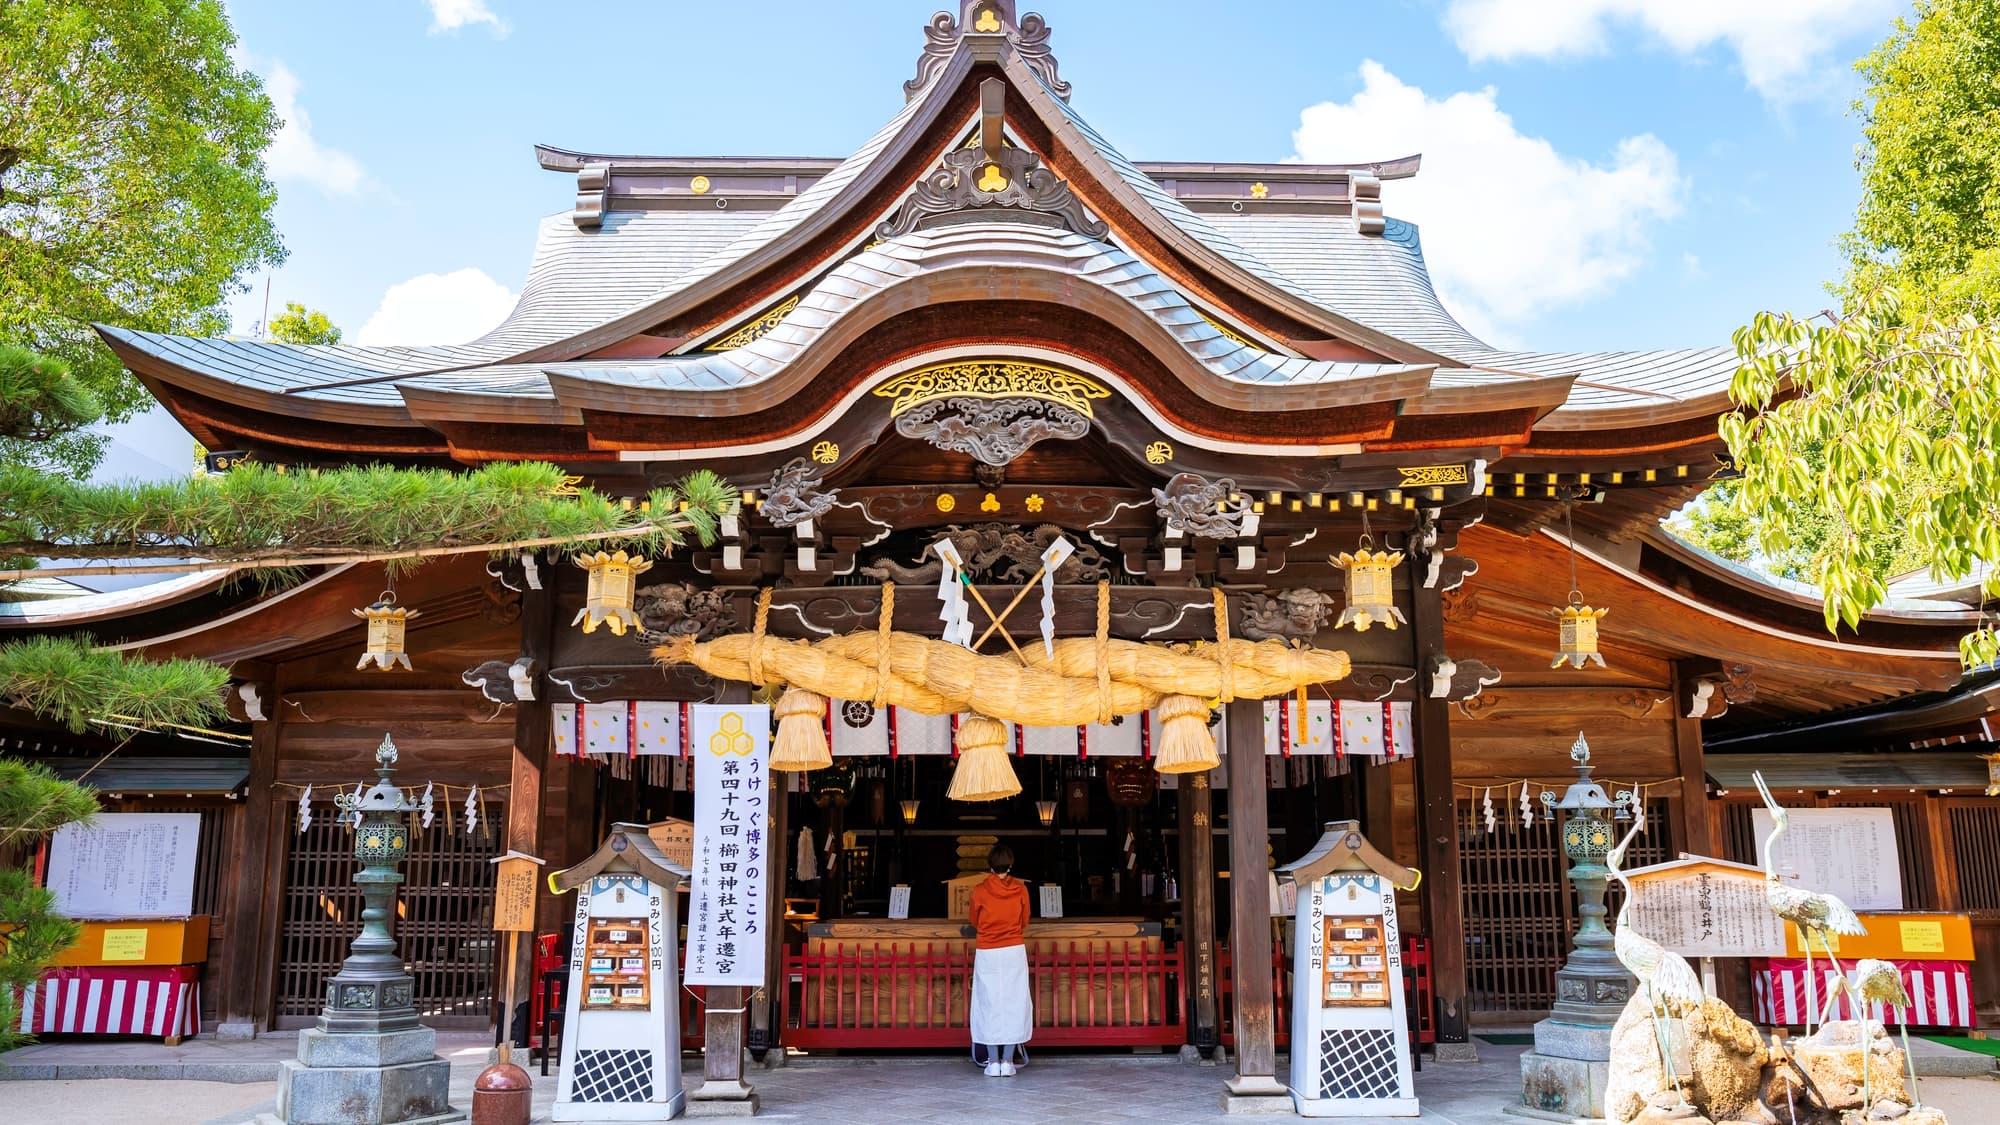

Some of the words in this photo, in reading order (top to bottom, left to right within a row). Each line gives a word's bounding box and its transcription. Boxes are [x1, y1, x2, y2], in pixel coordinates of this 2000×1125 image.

[720, 760, 740, 837] 第四十九回
[745, 758, 761, 934] うけつぐ博多のこころ
[572, 896, 589, 970] おみくじ100円
[650, 896, 663, 970] おみくじ100円
[1311, 895, 1323, 969] おみくじ100円
[1383, 894, 1400, 967] おみくじ100円
